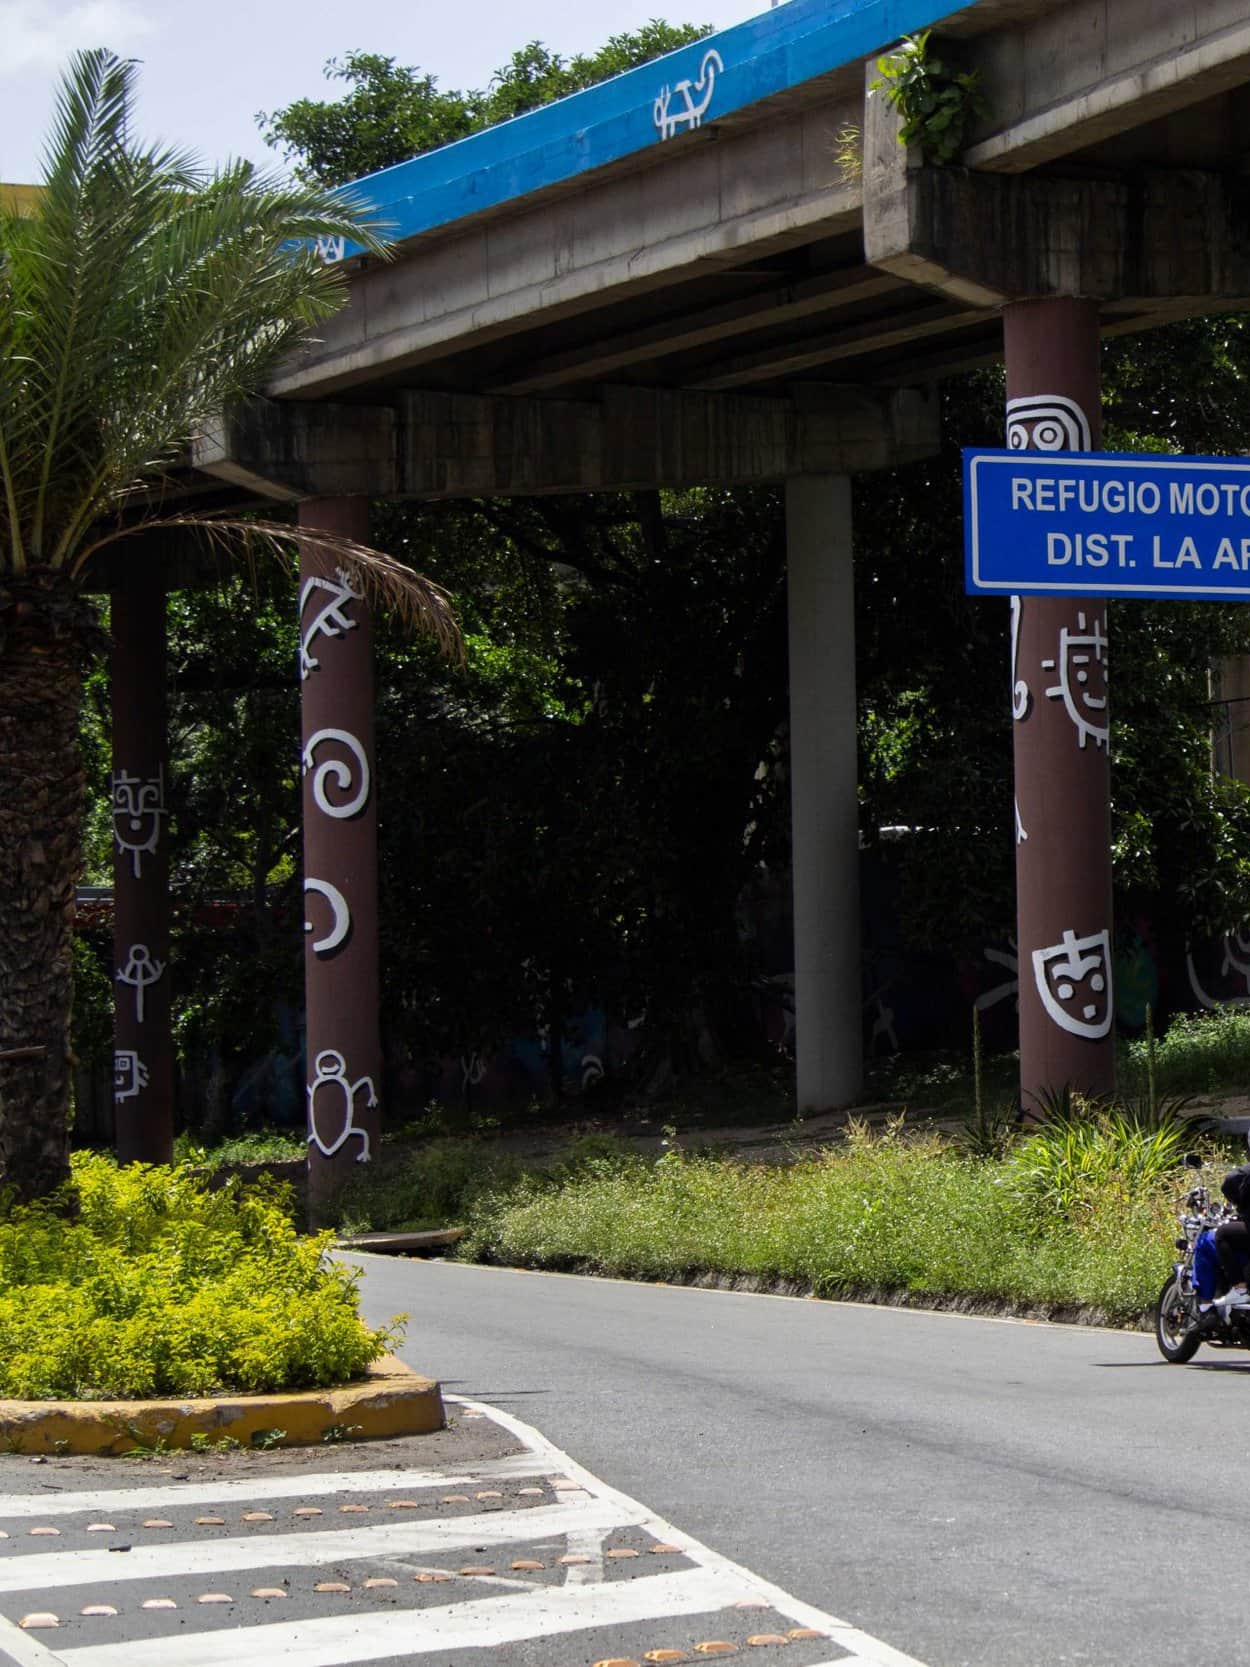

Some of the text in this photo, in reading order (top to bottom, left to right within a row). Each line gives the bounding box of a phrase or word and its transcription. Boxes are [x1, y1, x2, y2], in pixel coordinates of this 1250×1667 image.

[1011, 477, 1161, 515] REFUGIO
[1047, 532, 1136, 568] DIST.
[1153, 535, 1202, 569] LA
